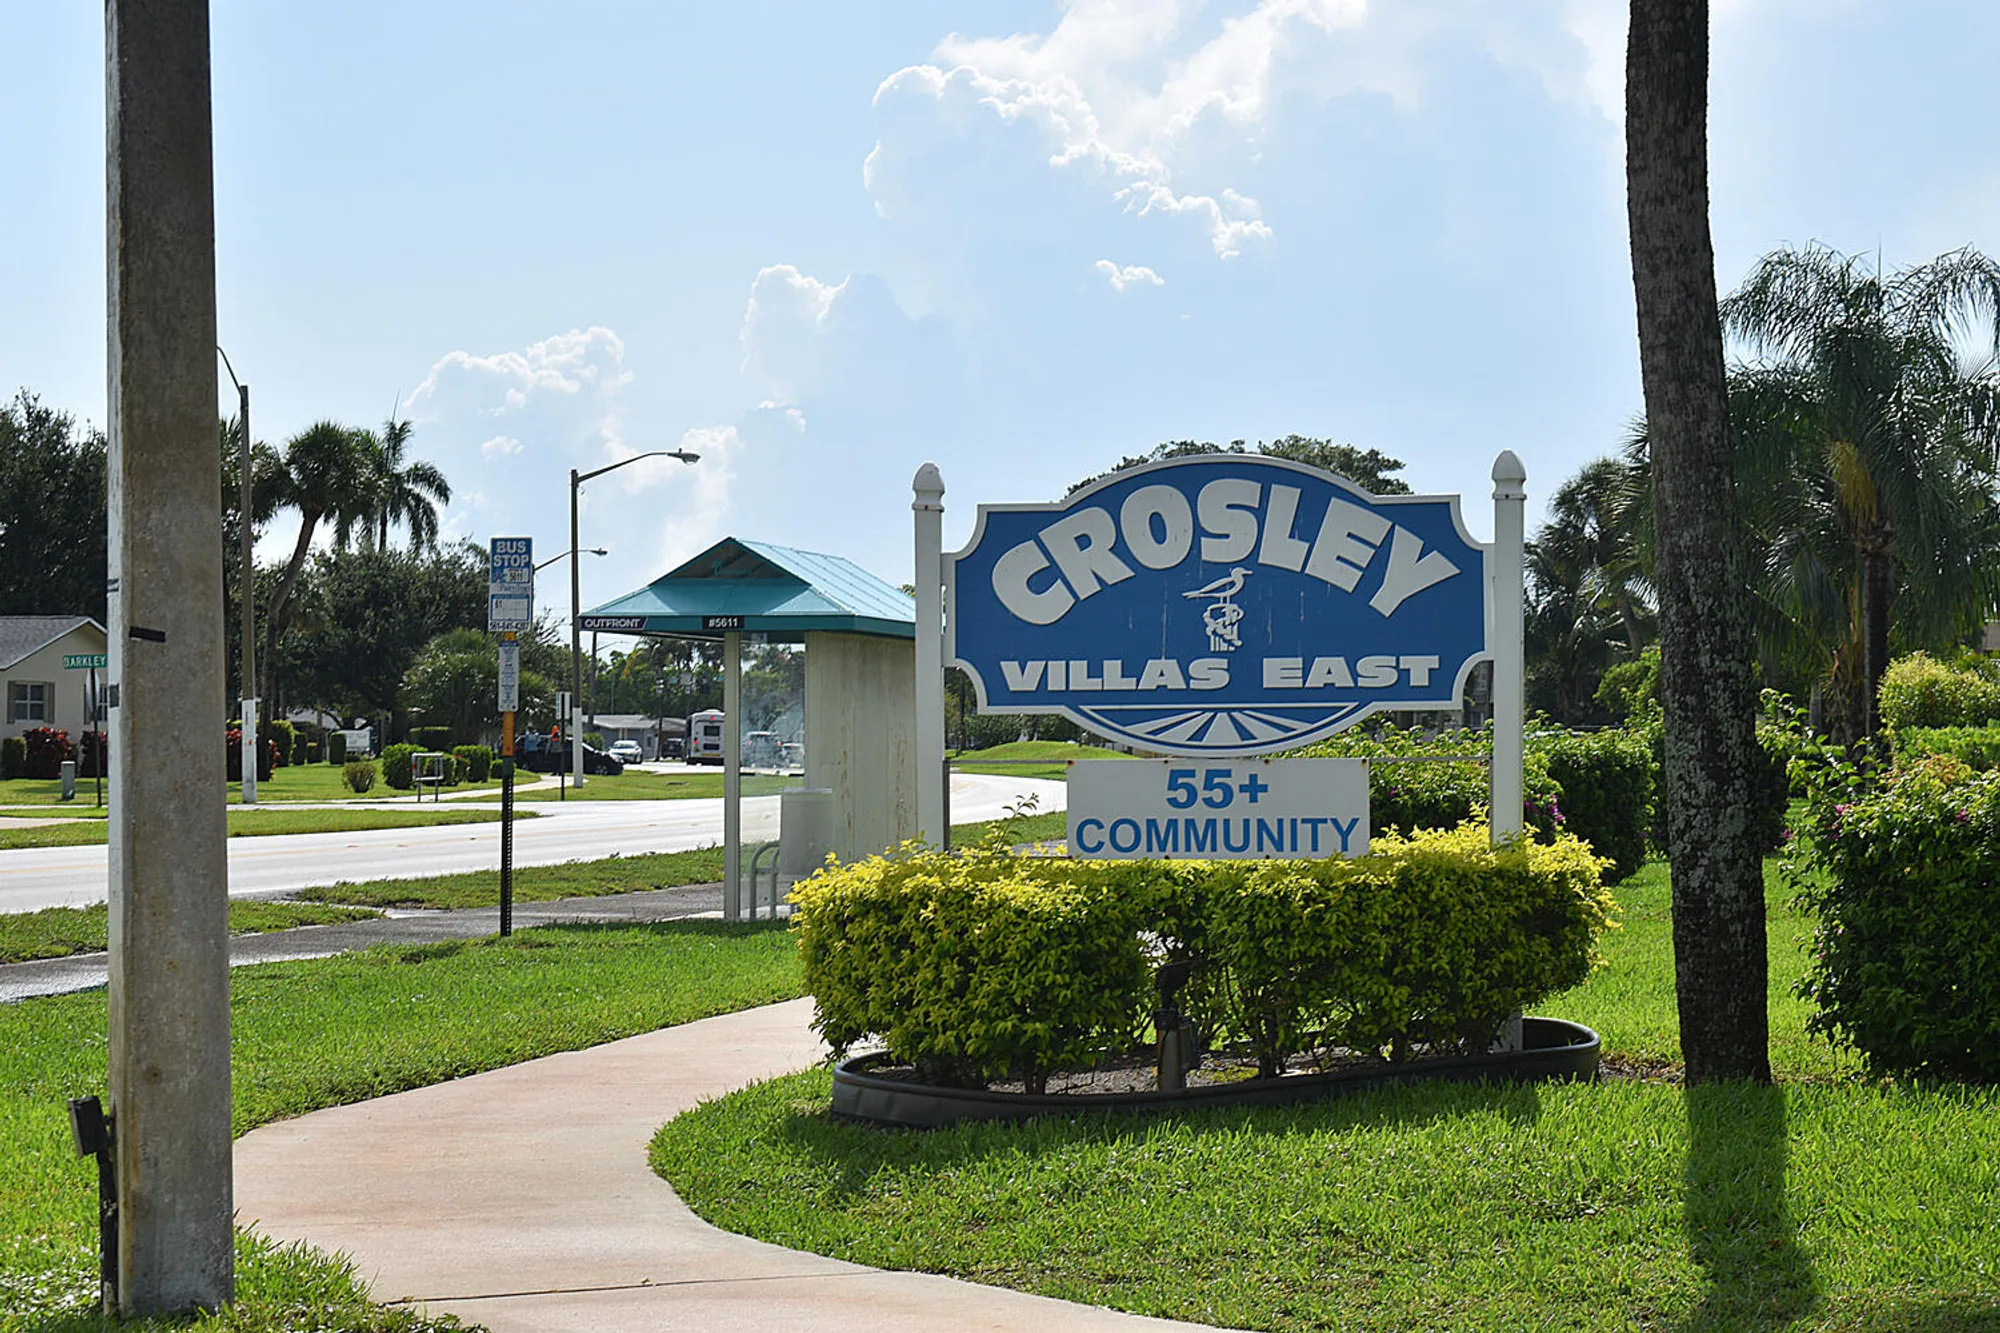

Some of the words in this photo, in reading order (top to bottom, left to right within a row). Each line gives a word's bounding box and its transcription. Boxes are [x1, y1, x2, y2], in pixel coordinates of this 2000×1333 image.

[496, 540, 527, 554] BUS
[991, 478, 1463, 625] CROSLEY
[493, 554, 530, 567] STOP
[584, 617, 641, 628] OUTFRONT
[708, 617, 738, 628] #5611
[1000, 658, 1231, 692] VILLAS
[1262, 655, 1440, 689] EAST
[1166, 769, 1269, 809] 55+
[1075, 817, 1360, 855] COMMUNITY
